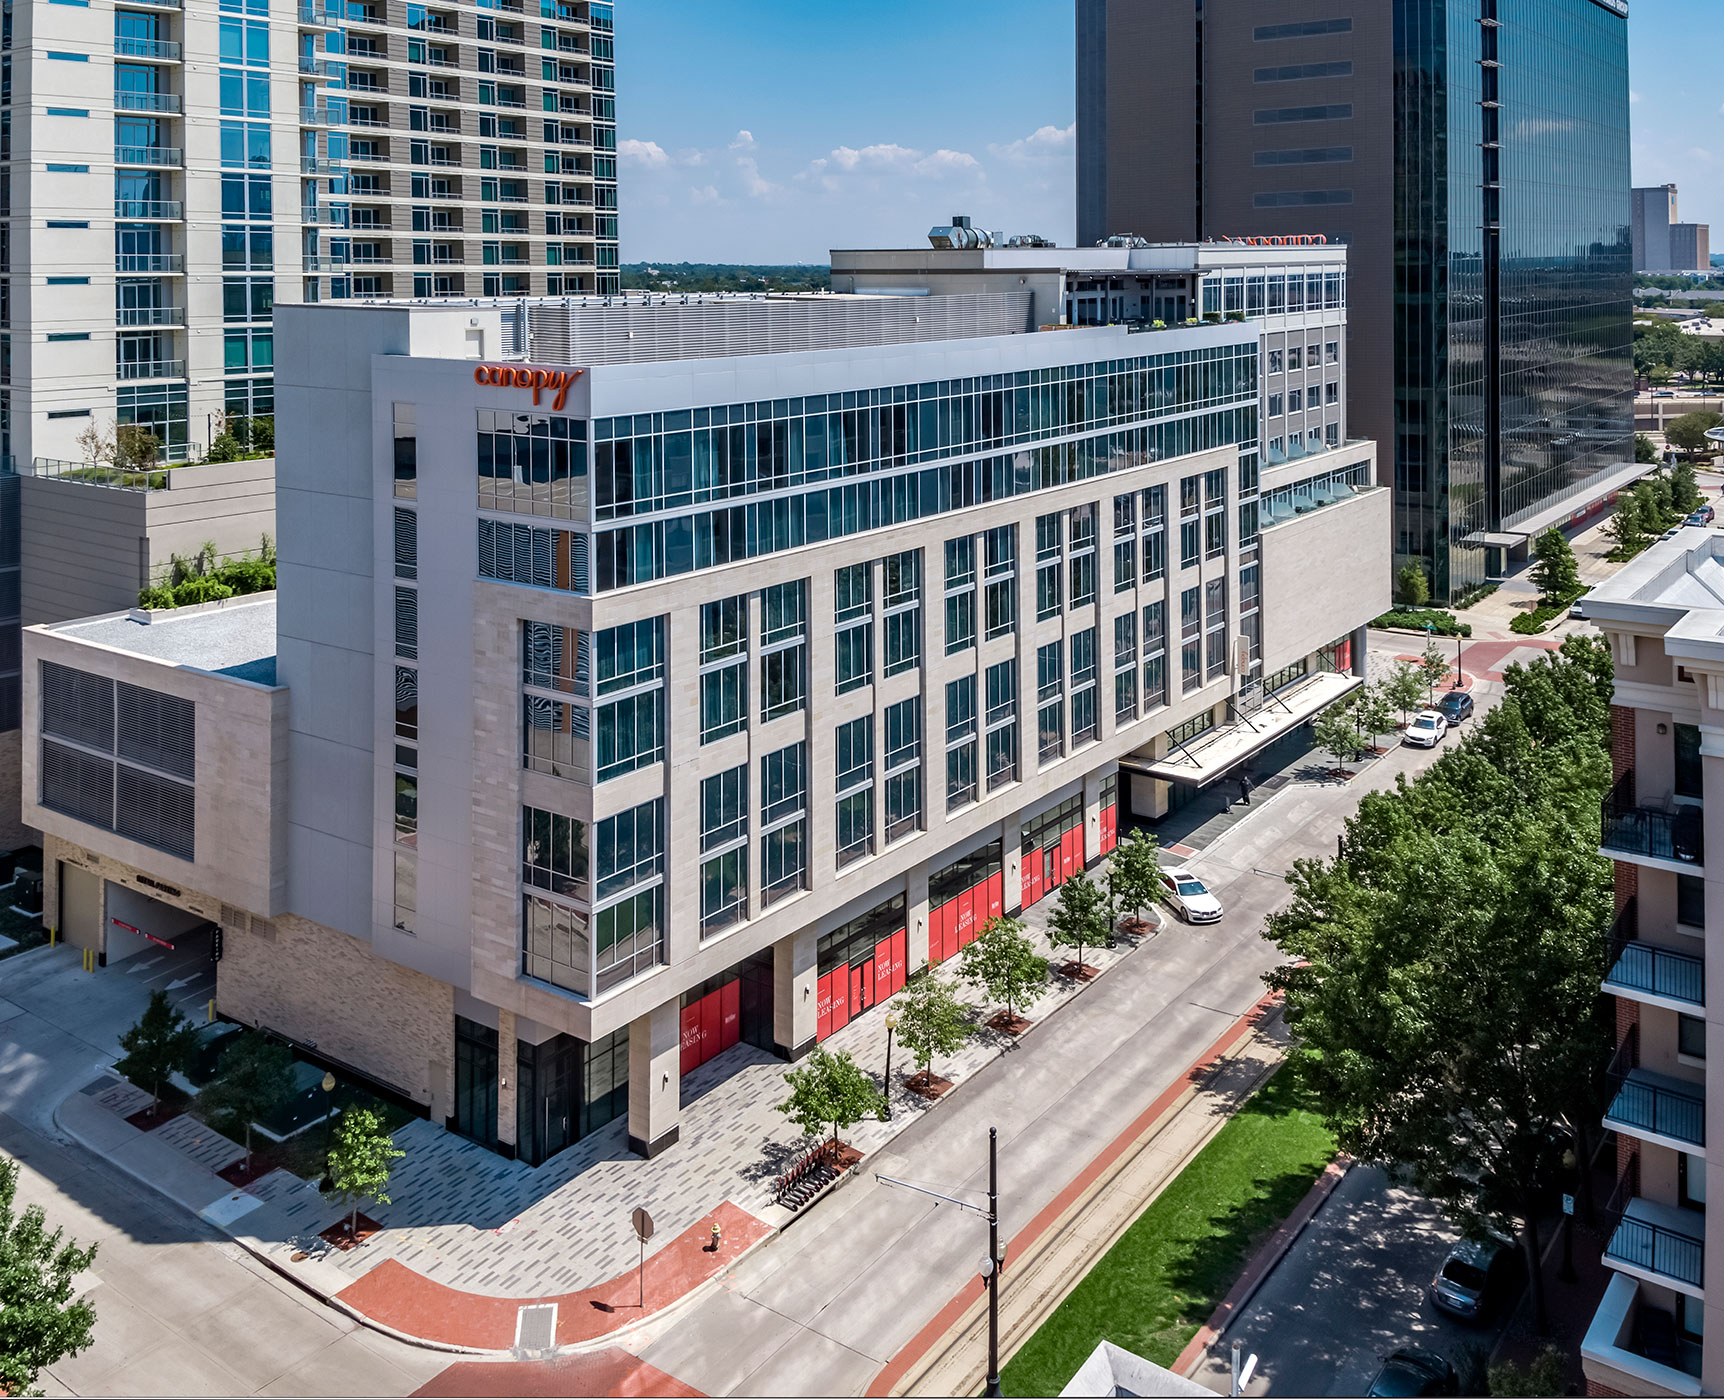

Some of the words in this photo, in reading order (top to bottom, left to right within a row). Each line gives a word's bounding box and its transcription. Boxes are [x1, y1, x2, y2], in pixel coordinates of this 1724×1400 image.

[474, 365, 583, 412] canopy
[877, 959, 903, 981] LEASING
[878, 958, 891, 973] NOW
[817, 994, 832, 1011] NOW
[817, 996, 845, 1019] LEASING
[680, 1029, 707, 1052] EASING
[682, 1024, 699, 1041] NOW
